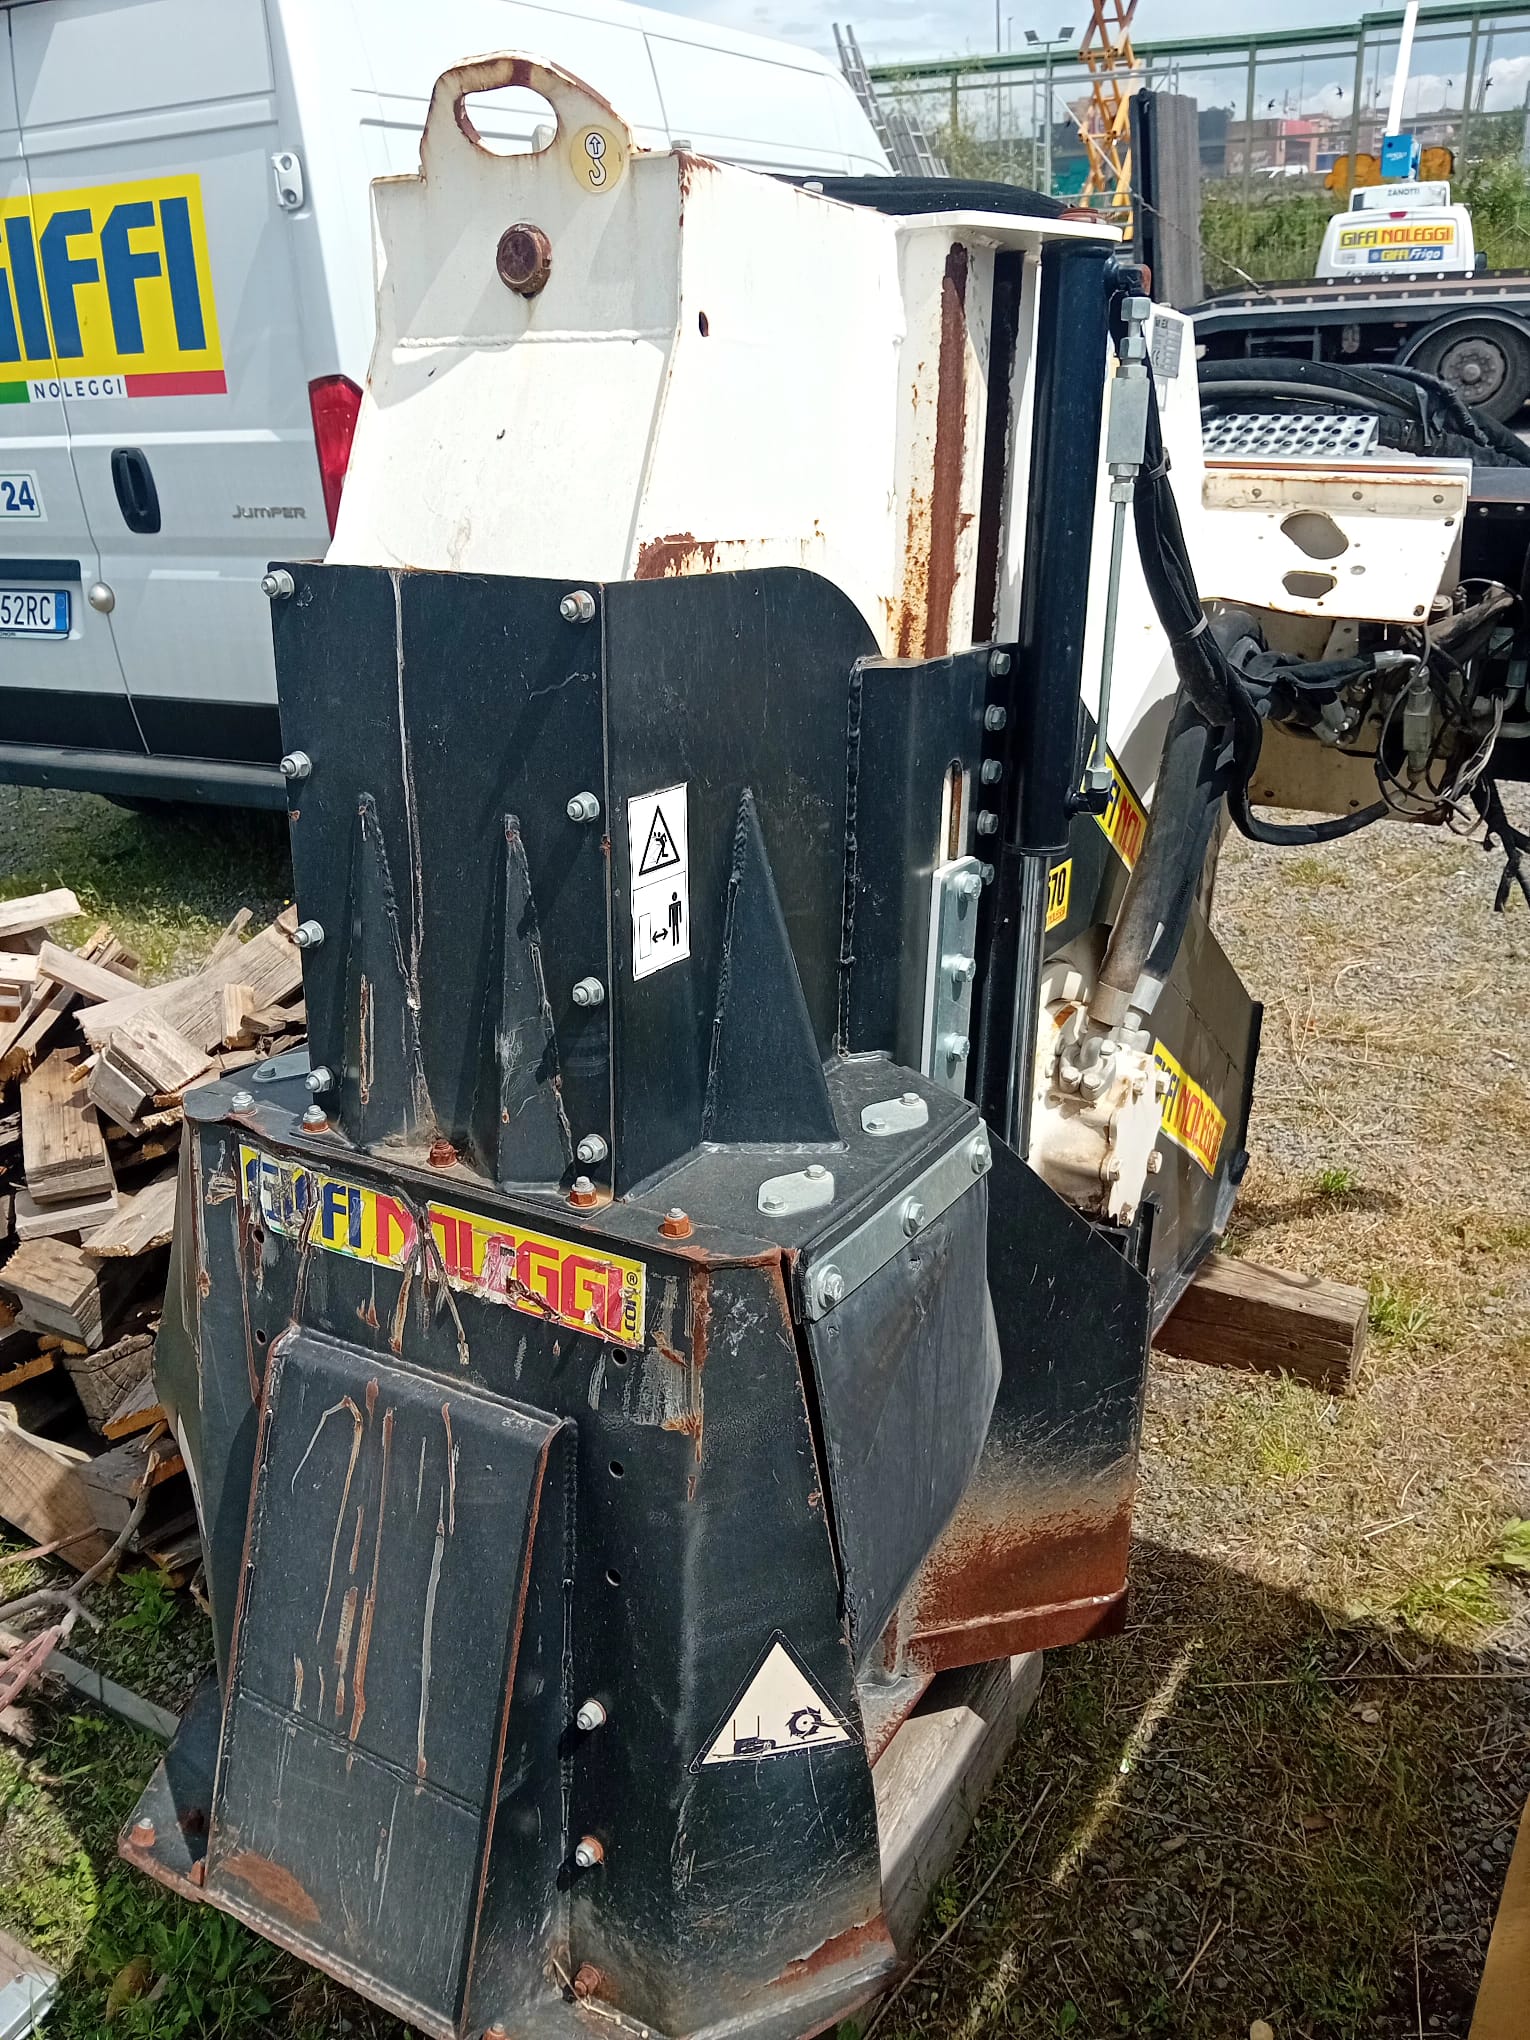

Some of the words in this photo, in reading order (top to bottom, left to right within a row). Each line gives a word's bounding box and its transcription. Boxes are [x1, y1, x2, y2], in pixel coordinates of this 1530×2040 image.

[1341, 230, 1378, 247] GIFFI
[1381, 226, 1450, 244] NOLEGGI
[1409, 248, 1441, 260] Frigo
[34, 377, 122, 399] NOLEGGI
[1, 480, 35, 512] 24
[0, 595, 51, 626] 52RC
